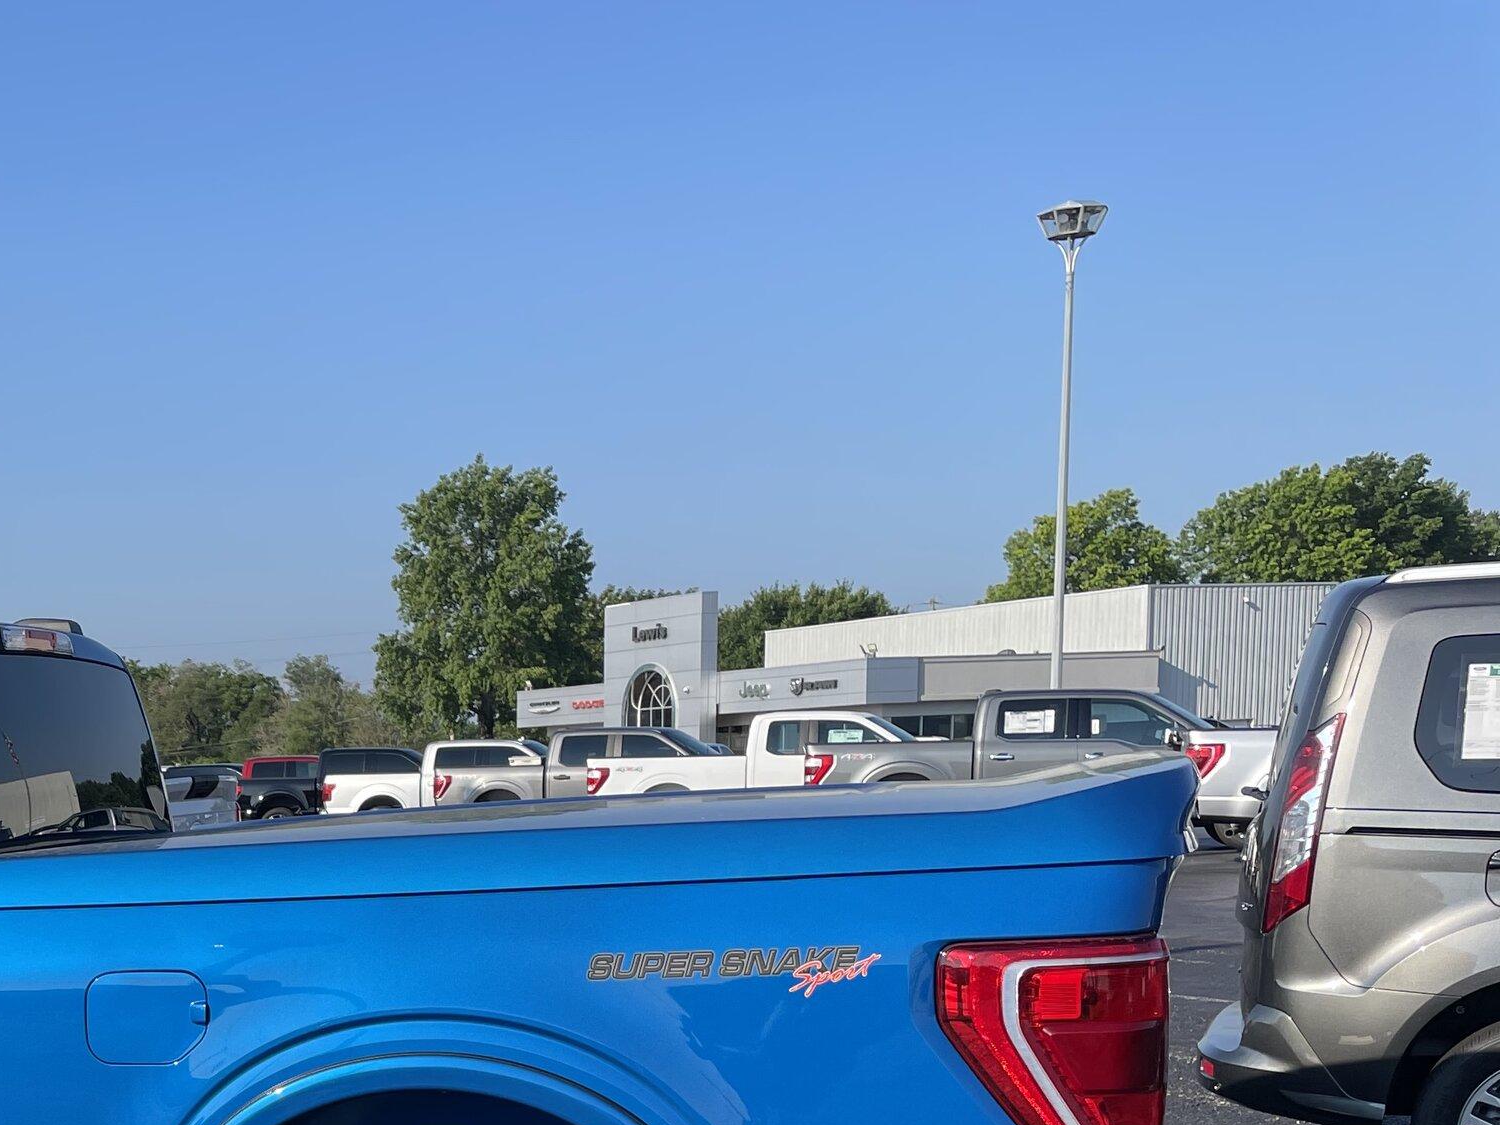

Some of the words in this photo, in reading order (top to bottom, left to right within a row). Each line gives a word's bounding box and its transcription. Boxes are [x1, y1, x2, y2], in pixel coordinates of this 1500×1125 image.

[739, 681, 770, 700] Jeep
[587, 949, 715, 981] SUPER
[719, 945, 860, 978] SNAKE
[788, 953, 881, 998] Sport
